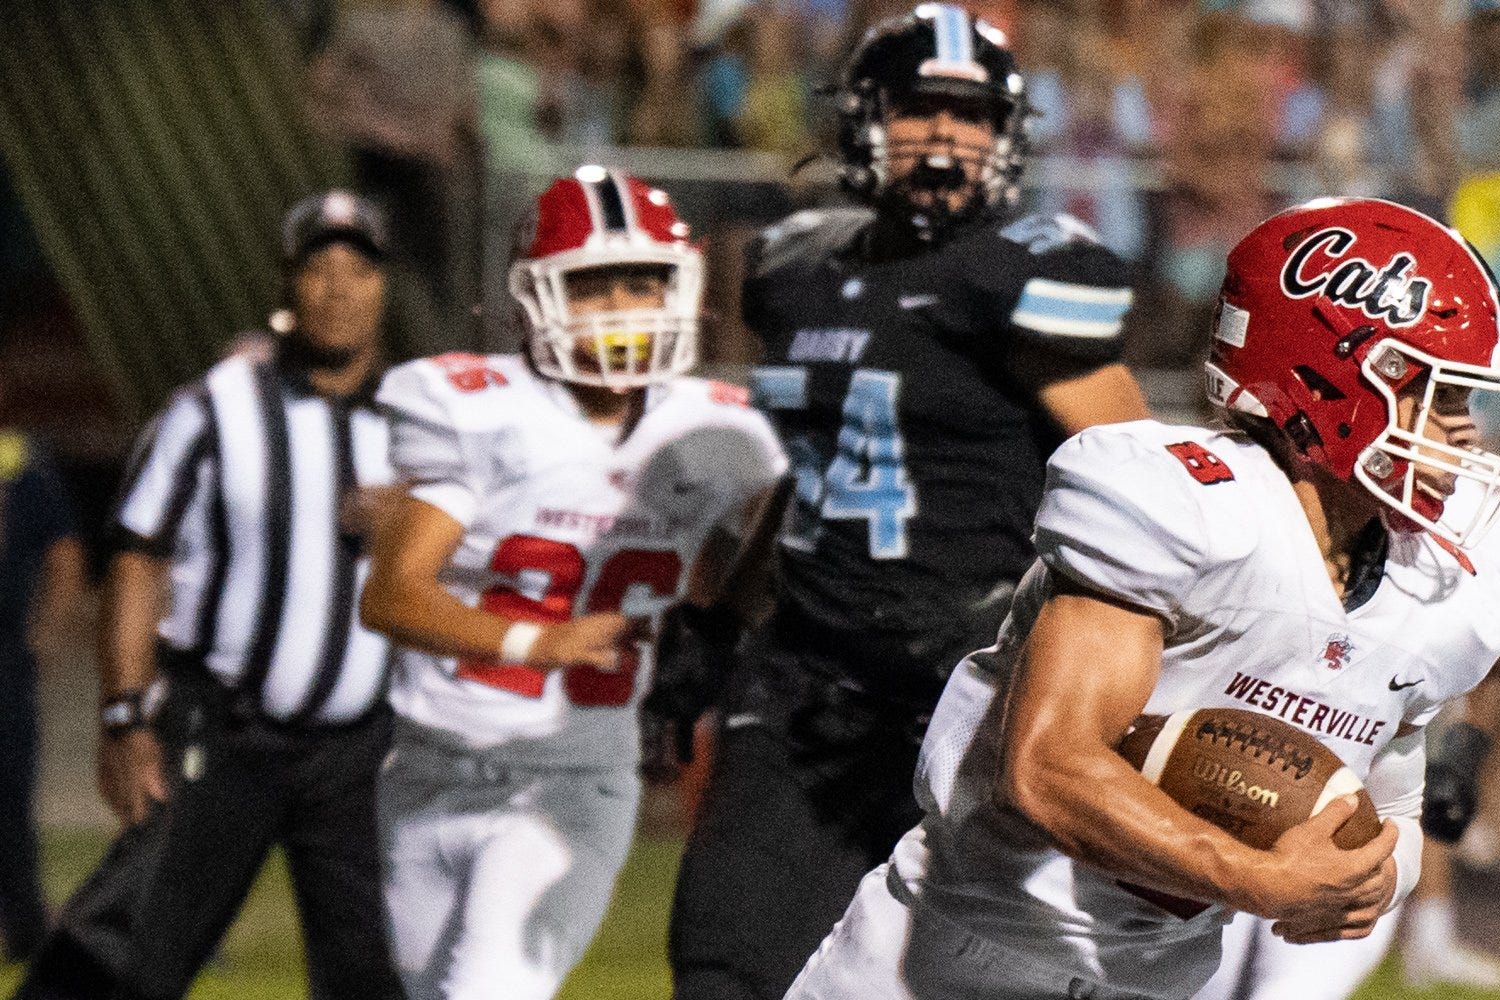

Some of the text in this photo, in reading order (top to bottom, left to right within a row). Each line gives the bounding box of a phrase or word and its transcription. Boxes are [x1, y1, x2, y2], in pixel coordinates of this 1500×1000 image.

[1280, 226, 1433, 329] Cats
[1164, 440, 1235, 486] 8
[1224, 671, 1387, 746] WESTERVILLE
[1194, 757, 1280, 808] Wilson
